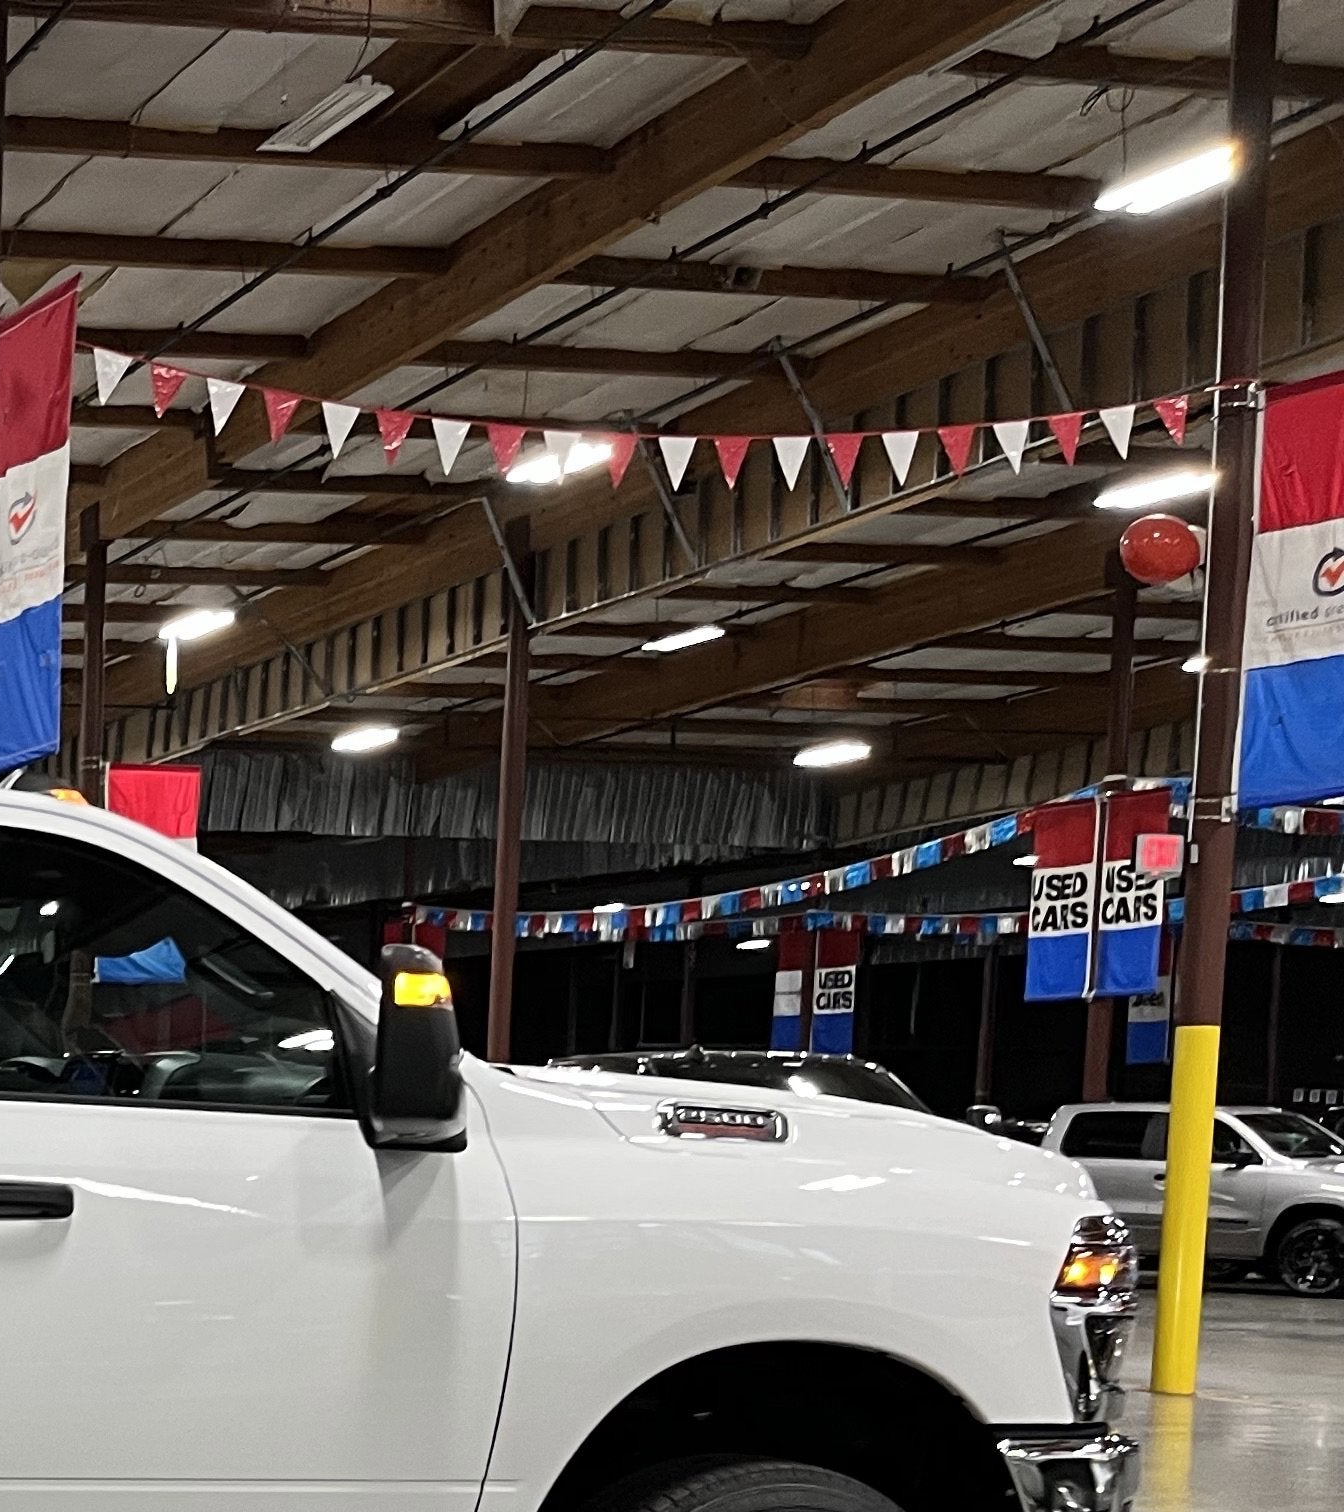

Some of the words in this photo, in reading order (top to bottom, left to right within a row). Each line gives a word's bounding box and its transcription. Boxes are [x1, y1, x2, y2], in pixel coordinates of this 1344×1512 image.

[1033, 871, 1088, 902] USED
[1031, 901, 1089, 932] CARS
[1102, 892, 1158, 925] CARS
[819, 971, 852, 989] USED
